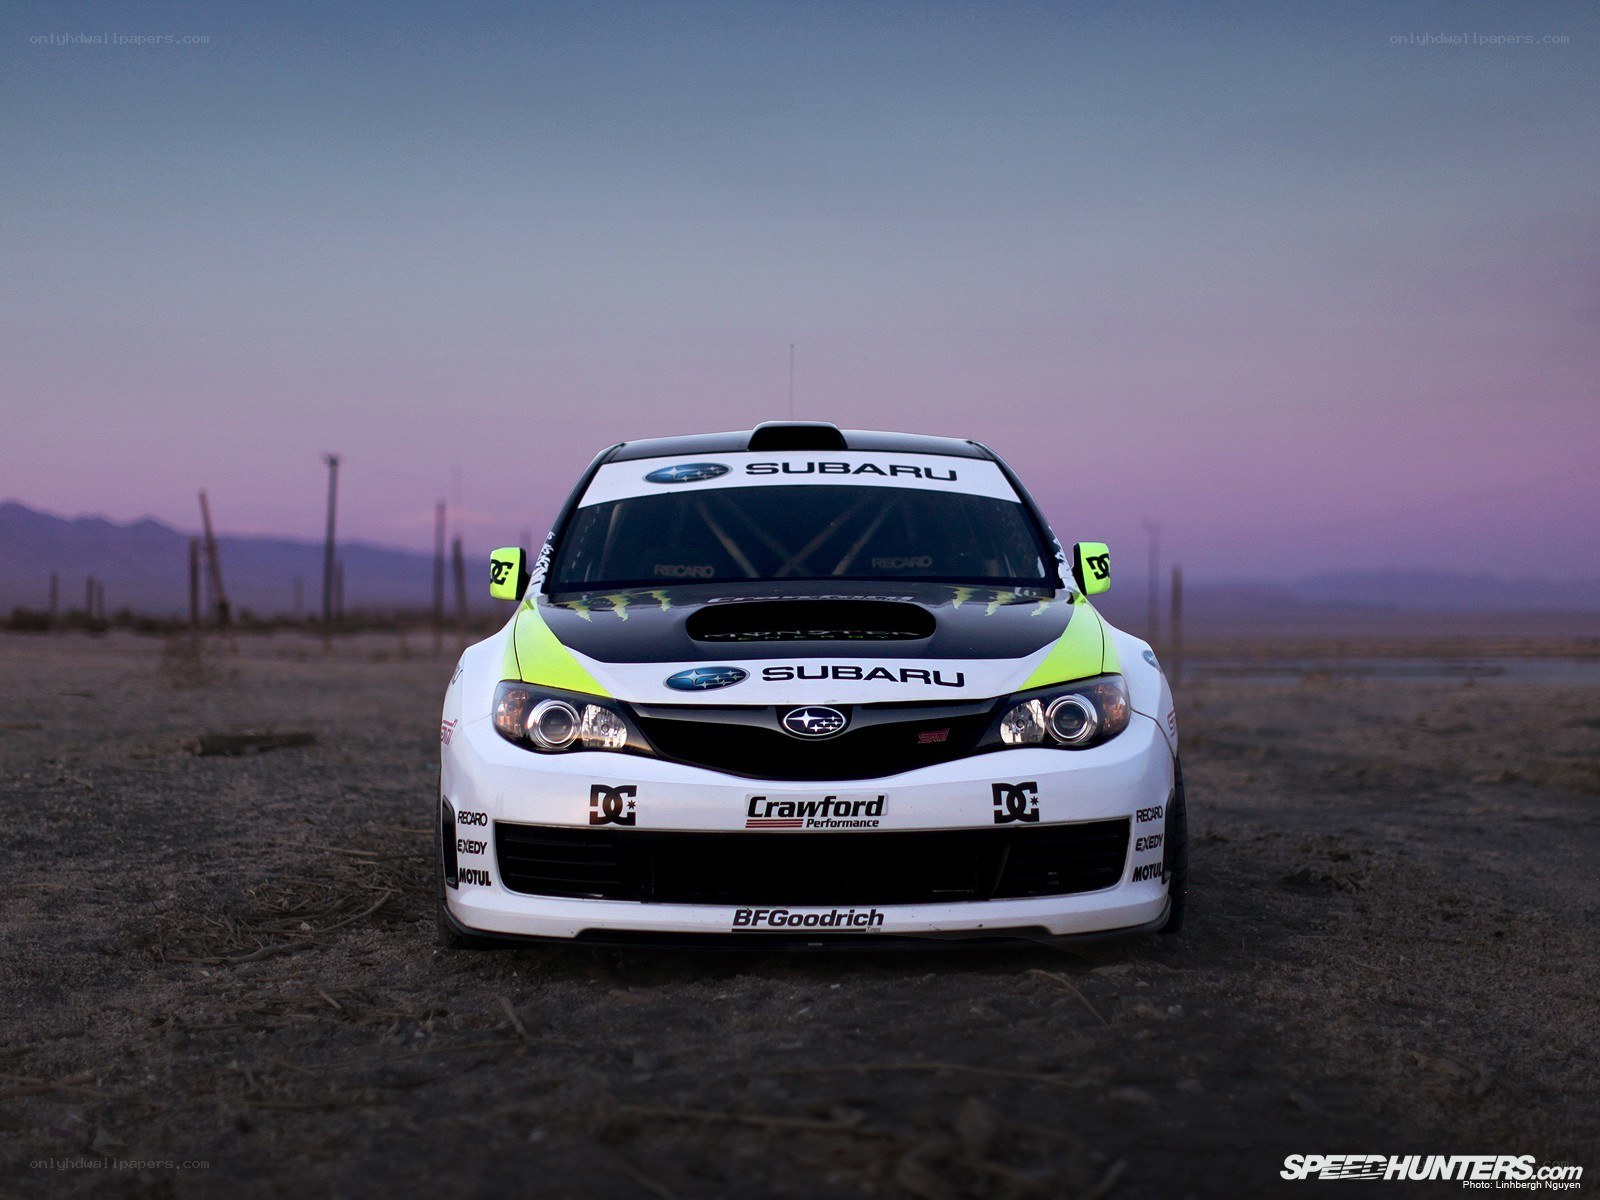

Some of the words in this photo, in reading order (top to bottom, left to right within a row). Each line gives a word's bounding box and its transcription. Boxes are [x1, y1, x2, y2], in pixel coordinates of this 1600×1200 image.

[745, 461, 958, 482] SUBARU
[654, 564, 715, 579] RECARO
[872, 555, 933, 569] RECARO
[762, 665, 965, 688] SUBARU
[589, 784, 638, 826] DC
[747, 795, 886, 818] Crawford
[991, 781, 1040, 824] DC
[457, 810, 488, 827] RECARO
[805, 818, 880, 828] Performance
[1136, 804, 1163, 824] RECARO
[457, 838, 488, 855] EXEDY
[1135, 832, 1163, 853] EXEDY
[459, 867, 492, 887] MOTUL
[1131, 861, 1163, 883] MOTUL
[732, 908, 885, 927] BFGoodrich
